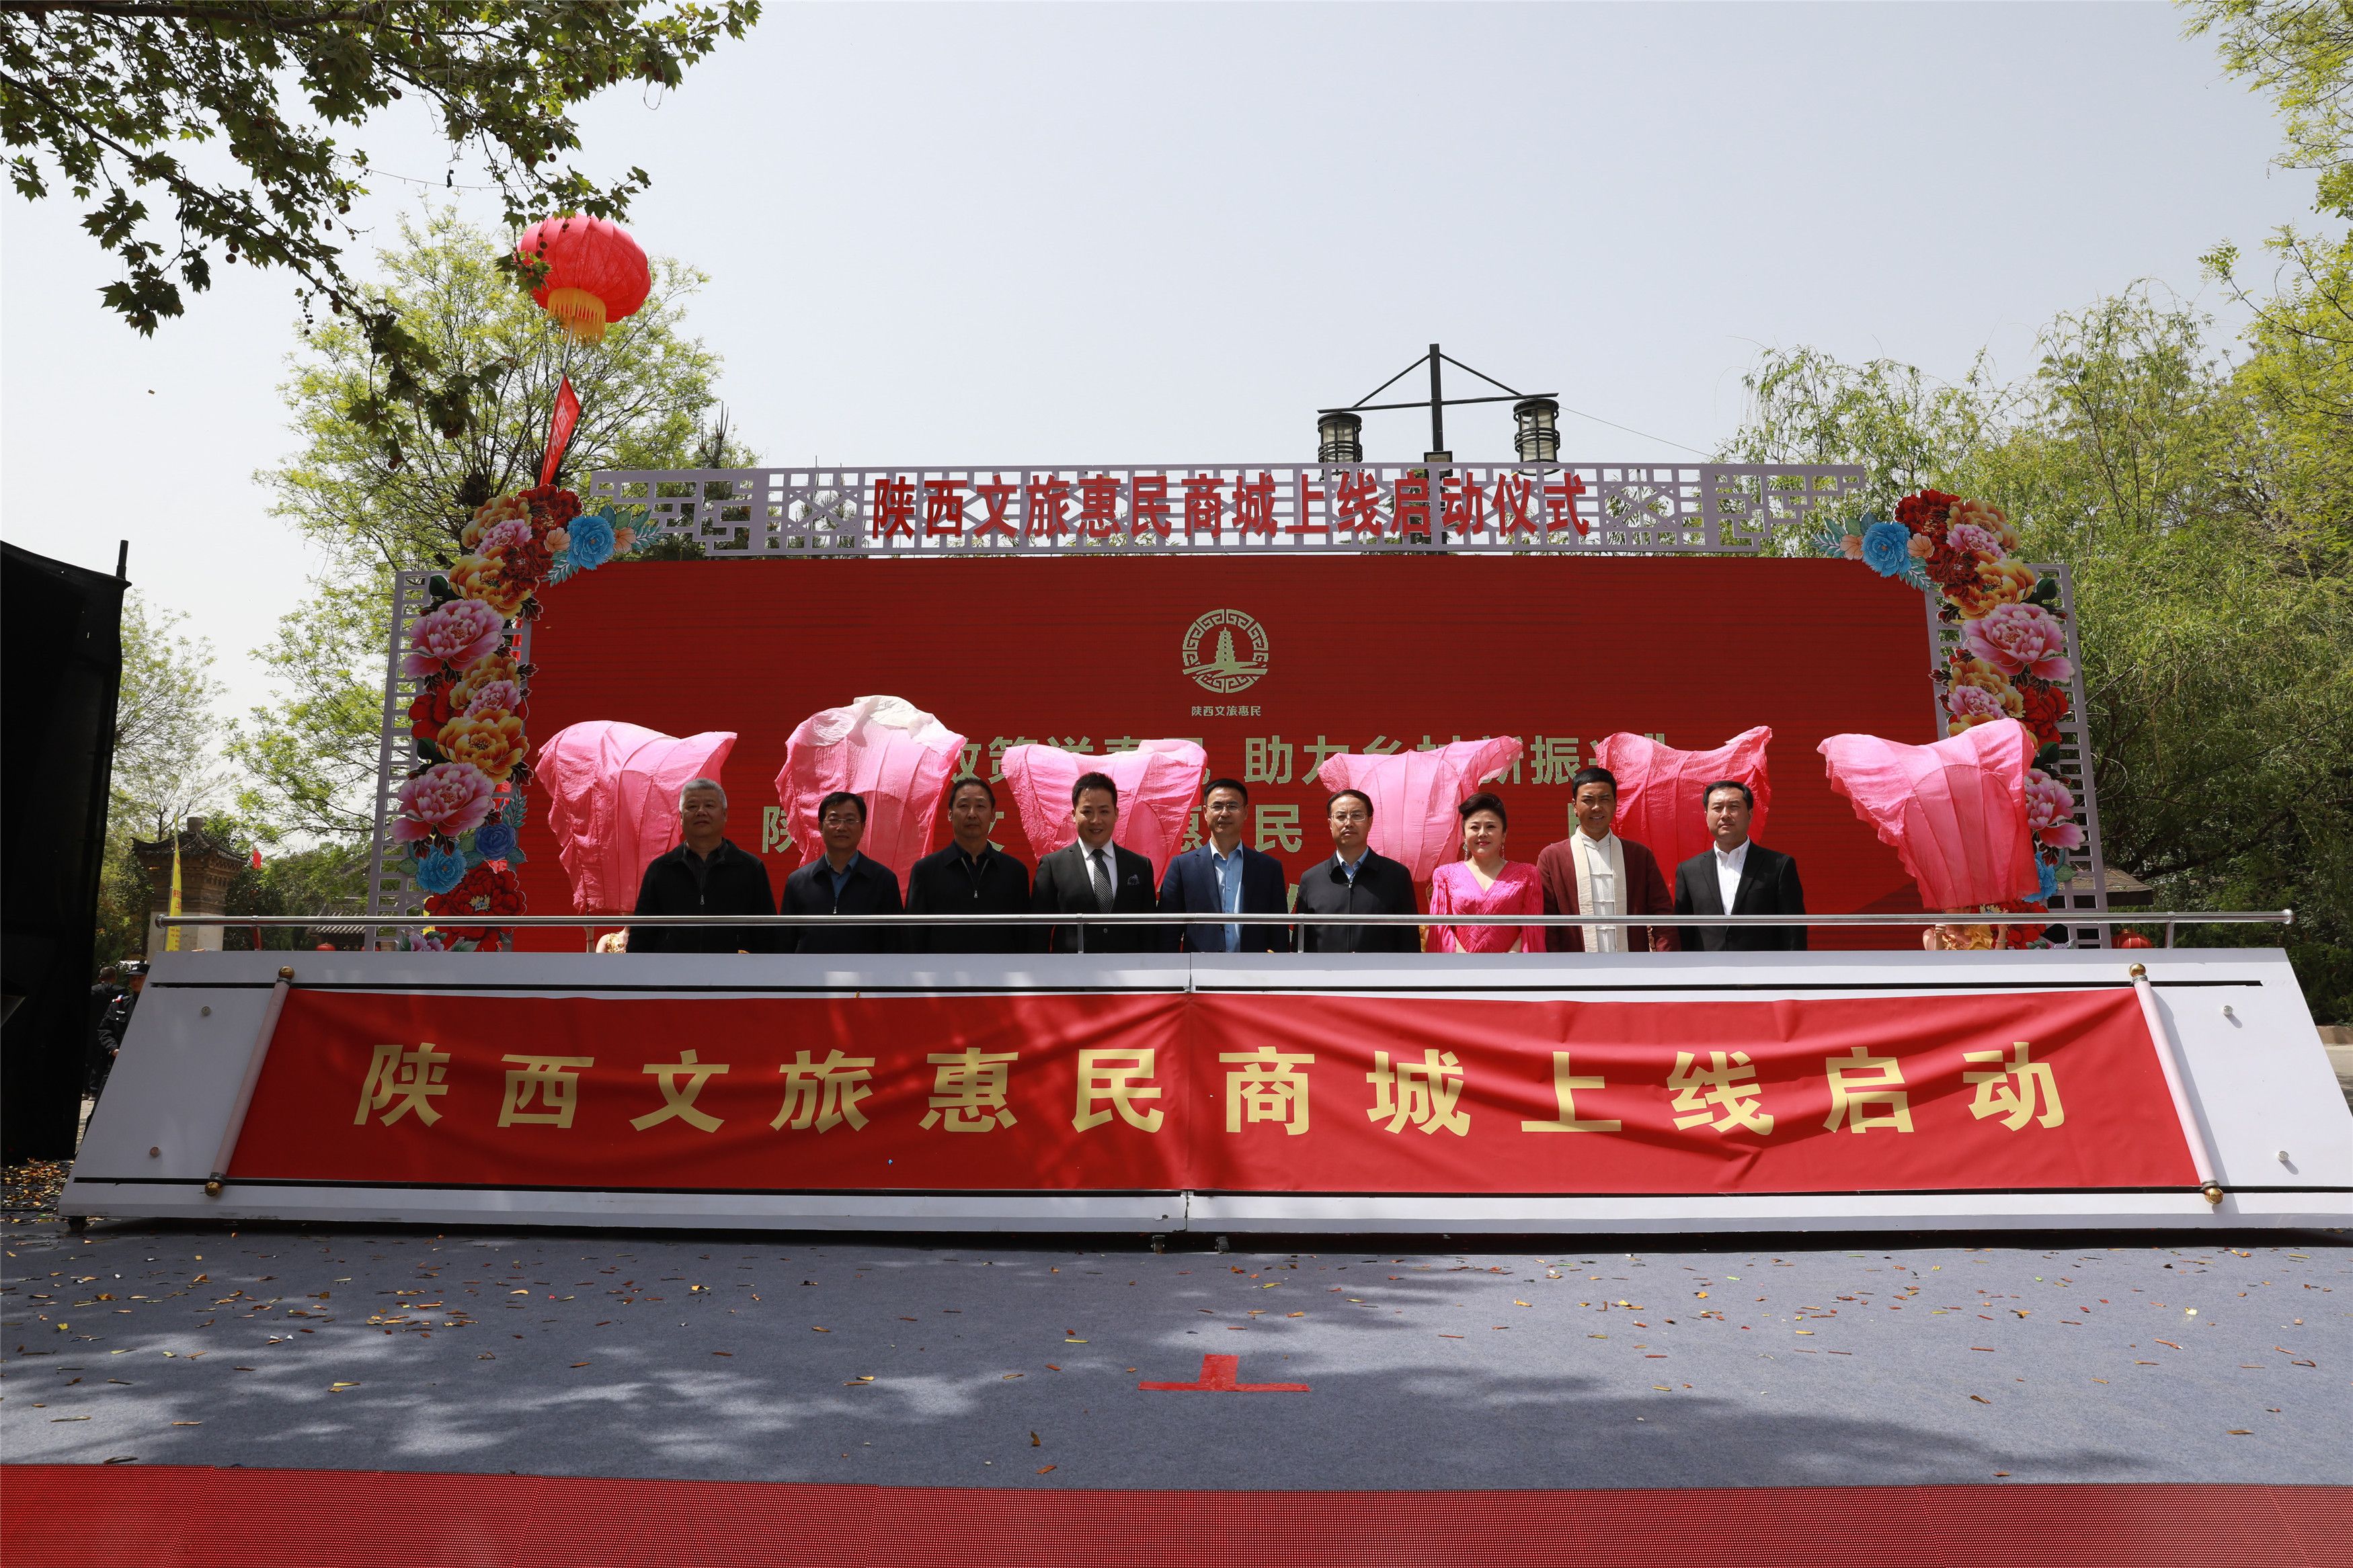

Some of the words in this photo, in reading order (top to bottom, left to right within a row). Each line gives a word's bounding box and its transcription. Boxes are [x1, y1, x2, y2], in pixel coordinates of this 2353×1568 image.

[872, 471, 1590, 538] 陕西文旅惠民商城上线启动仪式
[1191, 706, 1261, 716] 陕西文旅惠民
[354, 1042, 2065, 1136] 陕西文旅惠民商城上线启动
